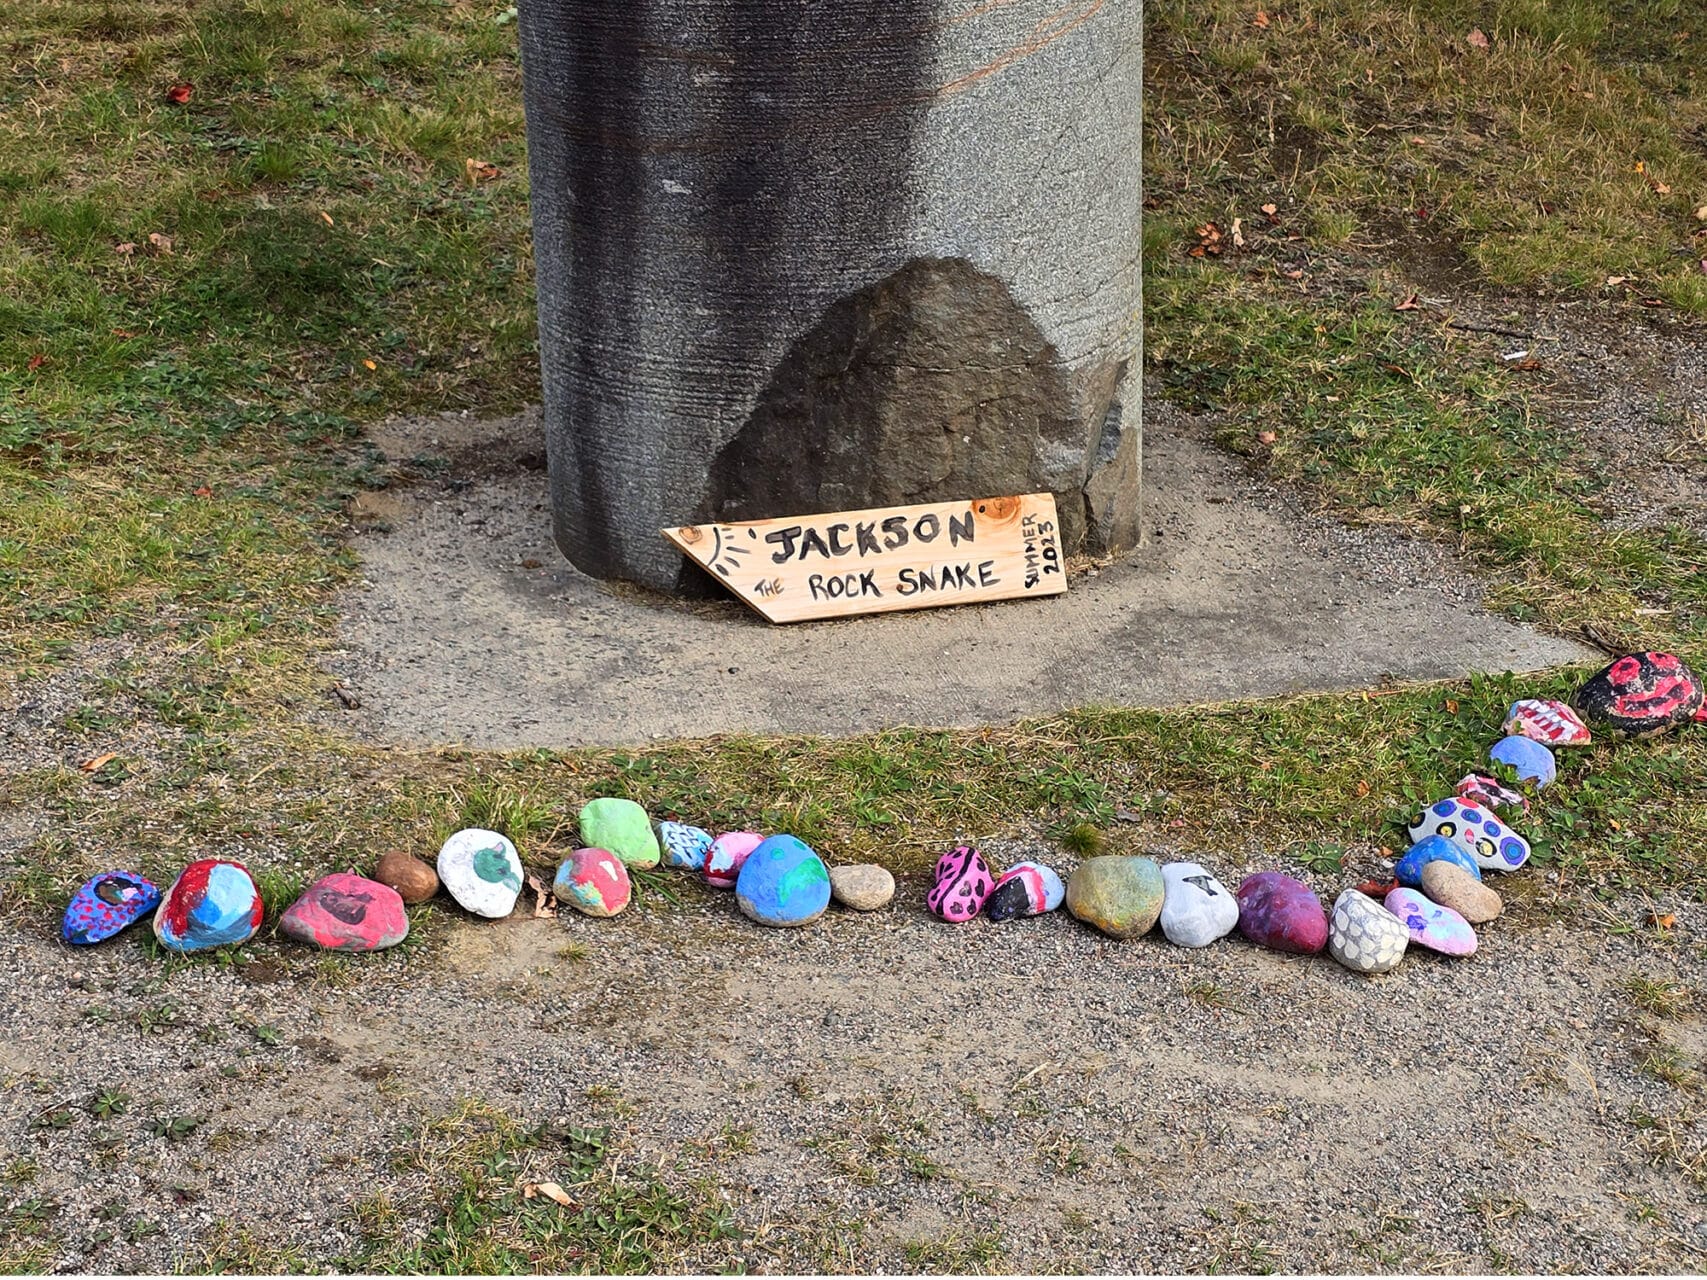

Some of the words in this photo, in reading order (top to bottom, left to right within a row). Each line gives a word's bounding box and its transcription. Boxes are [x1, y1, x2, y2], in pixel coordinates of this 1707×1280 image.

[765, 510, 974, 564] JACKSON
[1022, 512, 1040, 589] SUMMER
[1037, 520, 1060, 575] 2023
[754, 577, 785, 597] THE
[808, 568, 882, 600] ROCK
[897, 559, 1001, 596] SNAKE
